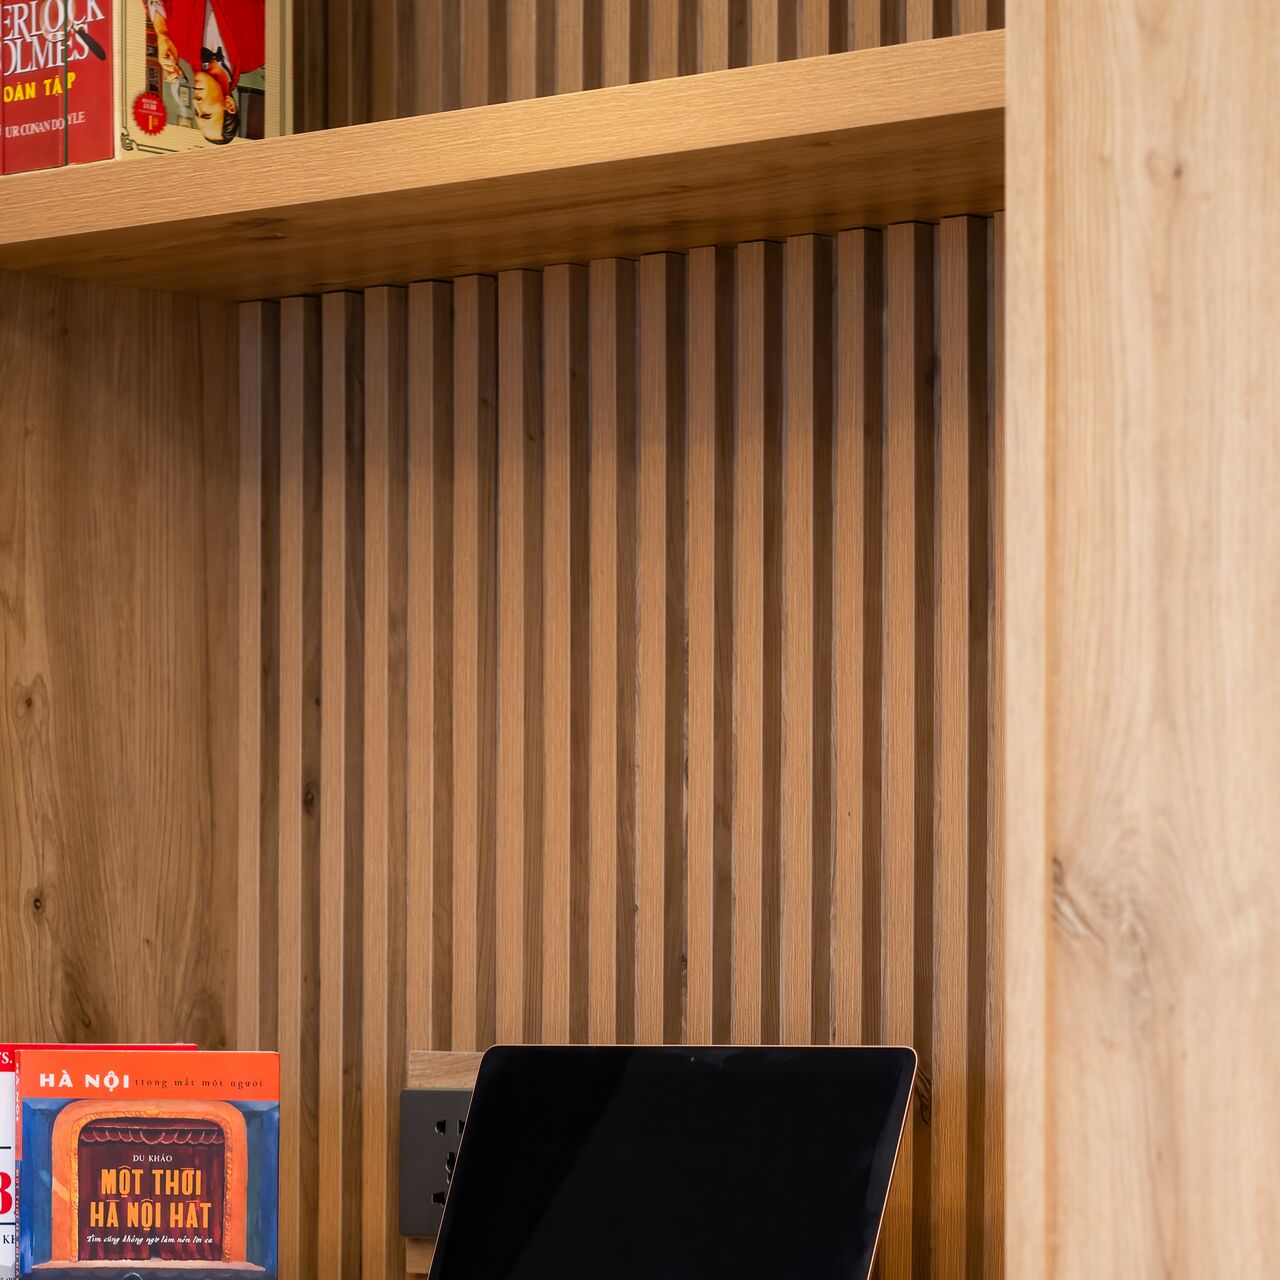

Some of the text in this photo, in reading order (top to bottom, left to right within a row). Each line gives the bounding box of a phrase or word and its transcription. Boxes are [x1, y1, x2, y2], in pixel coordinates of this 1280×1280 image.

[20, 119, 51, 136] CONAN
[40, 1069, 73, 1088] HÀ
[85, 1070, 129, 1092] NỘI
[135, 1078, 167, 1089] trong
[132, 1153, 173, 1162] DU KHẢO
[101, 1165, 144, 1198] MỘT
[90, 1199, 120, 1228] HÀ
[127, 1198, 161, 1231] NỘI
